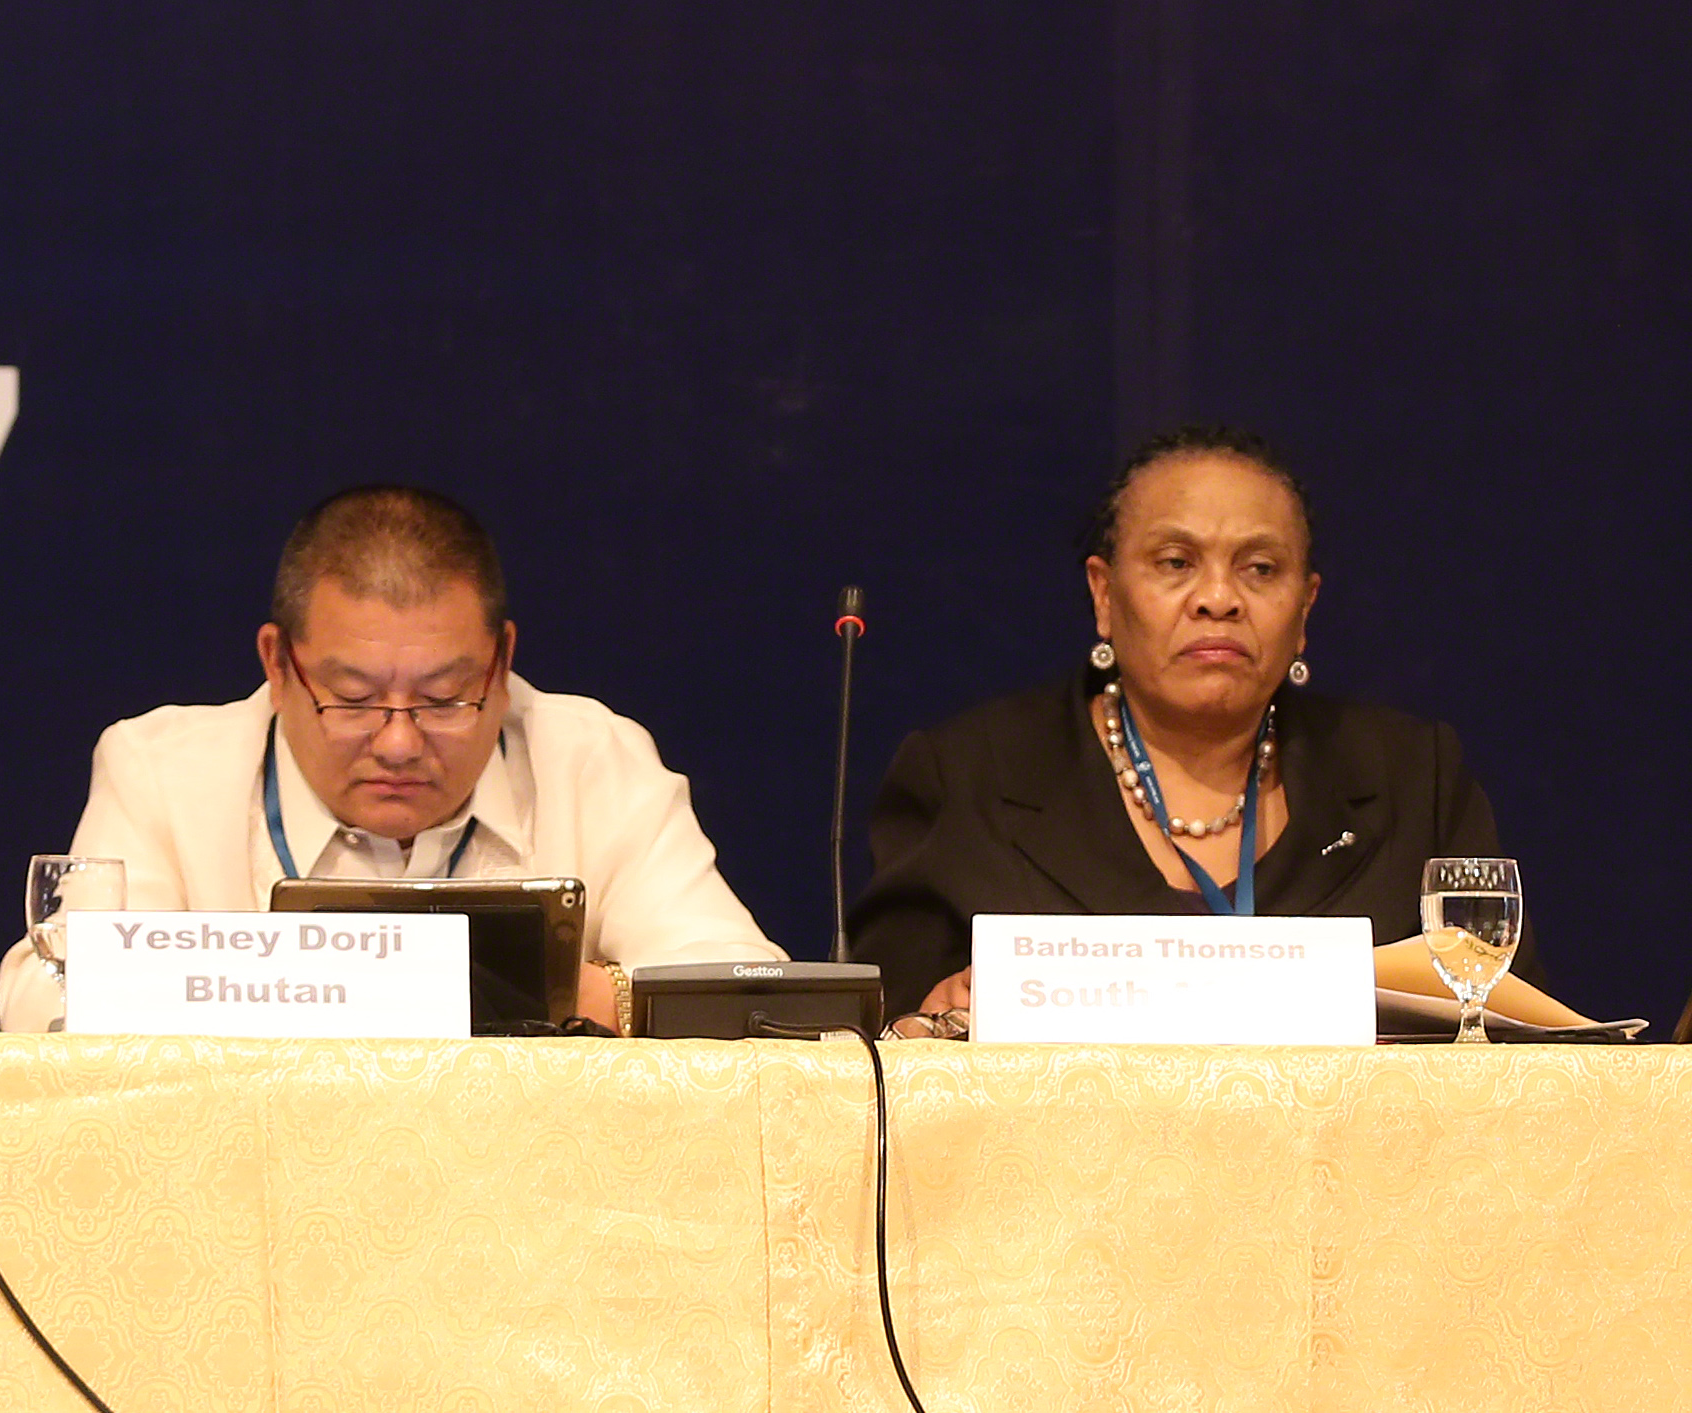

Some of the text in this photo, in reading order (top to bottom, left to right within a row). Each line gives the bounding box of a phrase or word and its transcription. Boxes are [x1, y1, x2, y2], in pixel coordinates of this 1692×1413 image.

[113, 923, 402, 959] Yeshey Dorji
[1014, 936, 1304, 959] Barbara Thomson
[733, 965, 783, 978] Gestton
[186, 976, 346, 1004] Bhutan
[1020, 979, 1148, 1008] South
